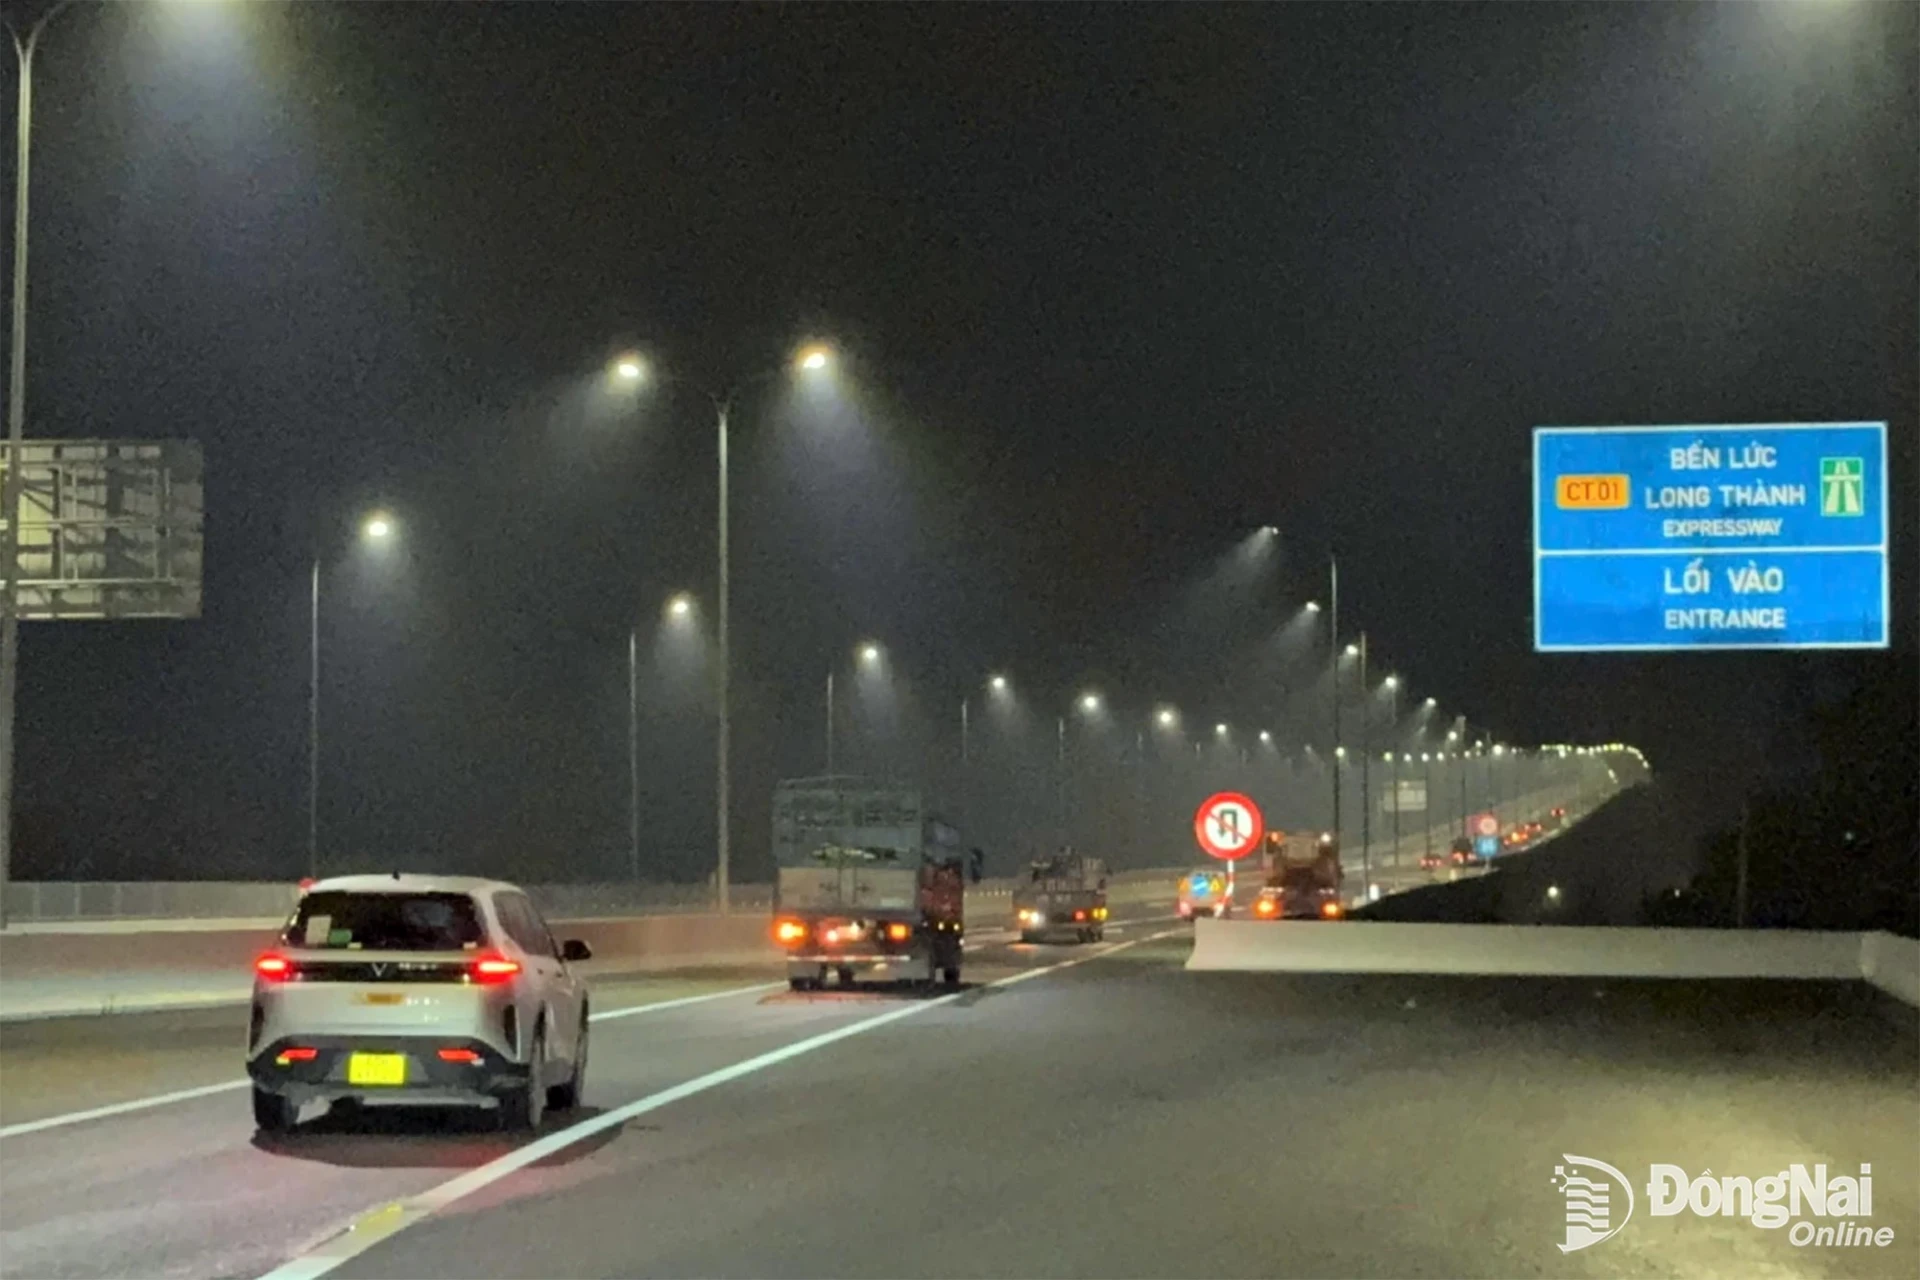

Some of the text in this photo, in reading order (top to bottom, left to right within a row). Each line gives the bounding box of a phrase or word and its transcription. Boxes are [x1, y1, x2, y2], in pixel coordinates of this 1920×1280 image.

[1670, 439, 1777, 470] BẾN LỨC
[1645, 478, 1806, 509] LONG THÀNH
[1663, 517, 1783, 538] EXPRESSWAY
[1664, 557, 1784, 594] LỐI VÀO
[1664, 607, 1786, 630] ENTRANCE
